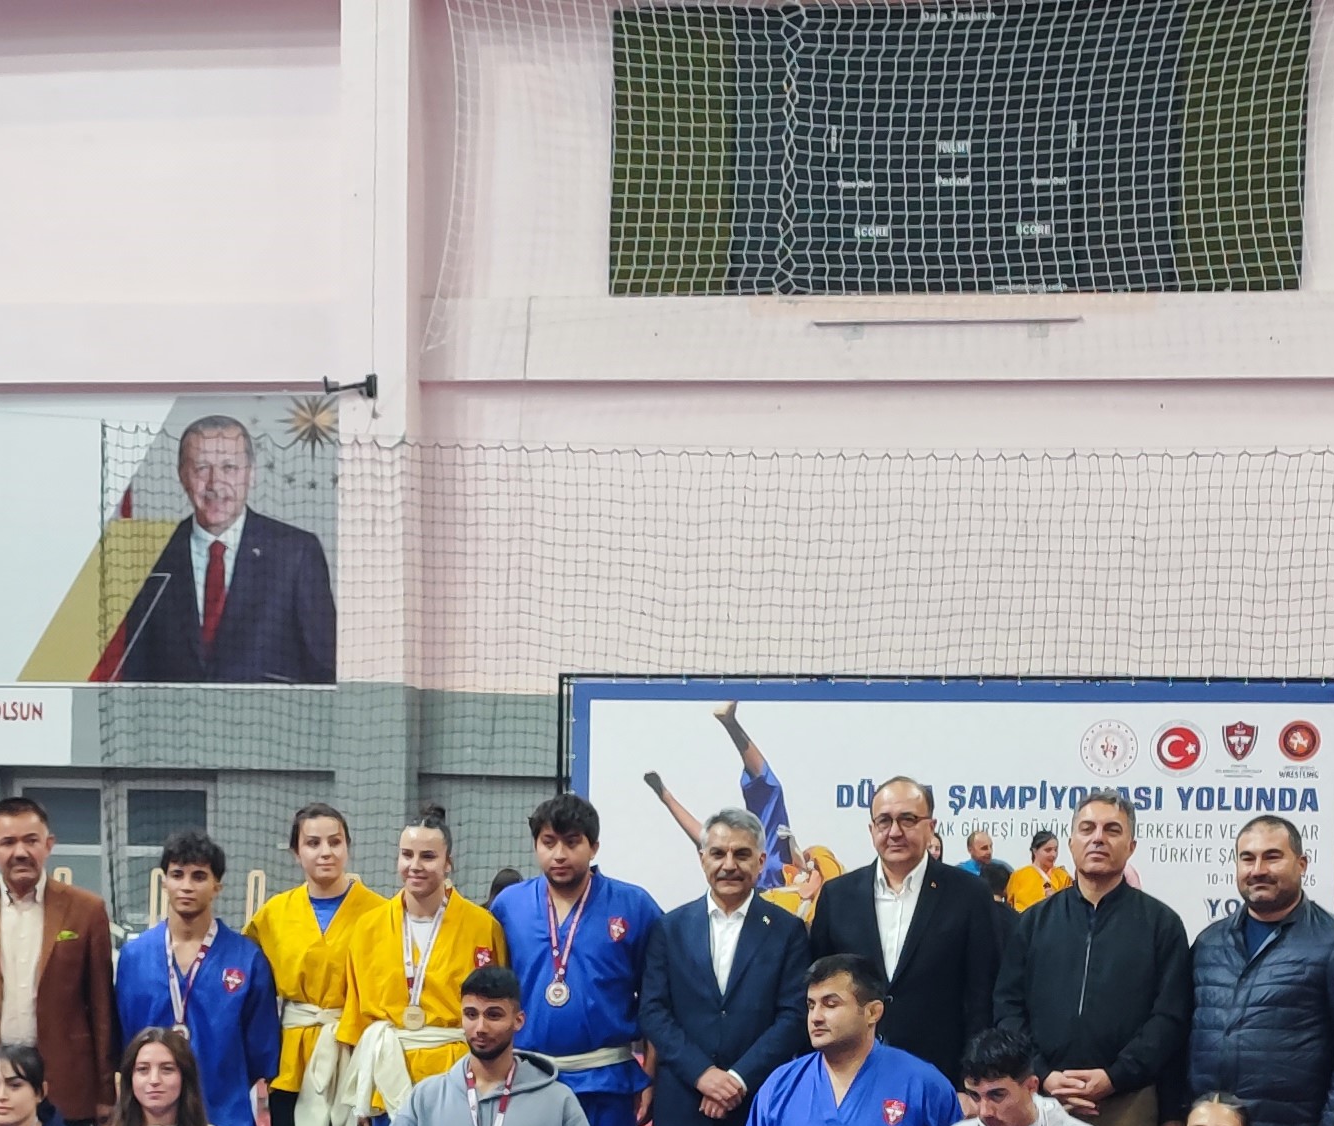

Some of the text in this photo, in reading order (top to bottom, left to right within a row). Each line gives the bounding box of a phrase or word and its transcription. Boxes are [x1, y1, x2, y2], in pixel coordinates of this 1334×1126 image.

[1177, 786, 1320, 812] YOLUNDA
[961, 817, 1013, 840] GÜREŞİ
[1020, 817, 1069, 838] BÜYÜK
[1136, 823, 1213, 839] ERKEKLER
[1219, 823, 1237, 839] VE
[1150, 843, 1213, 863] TÜRKİYE
